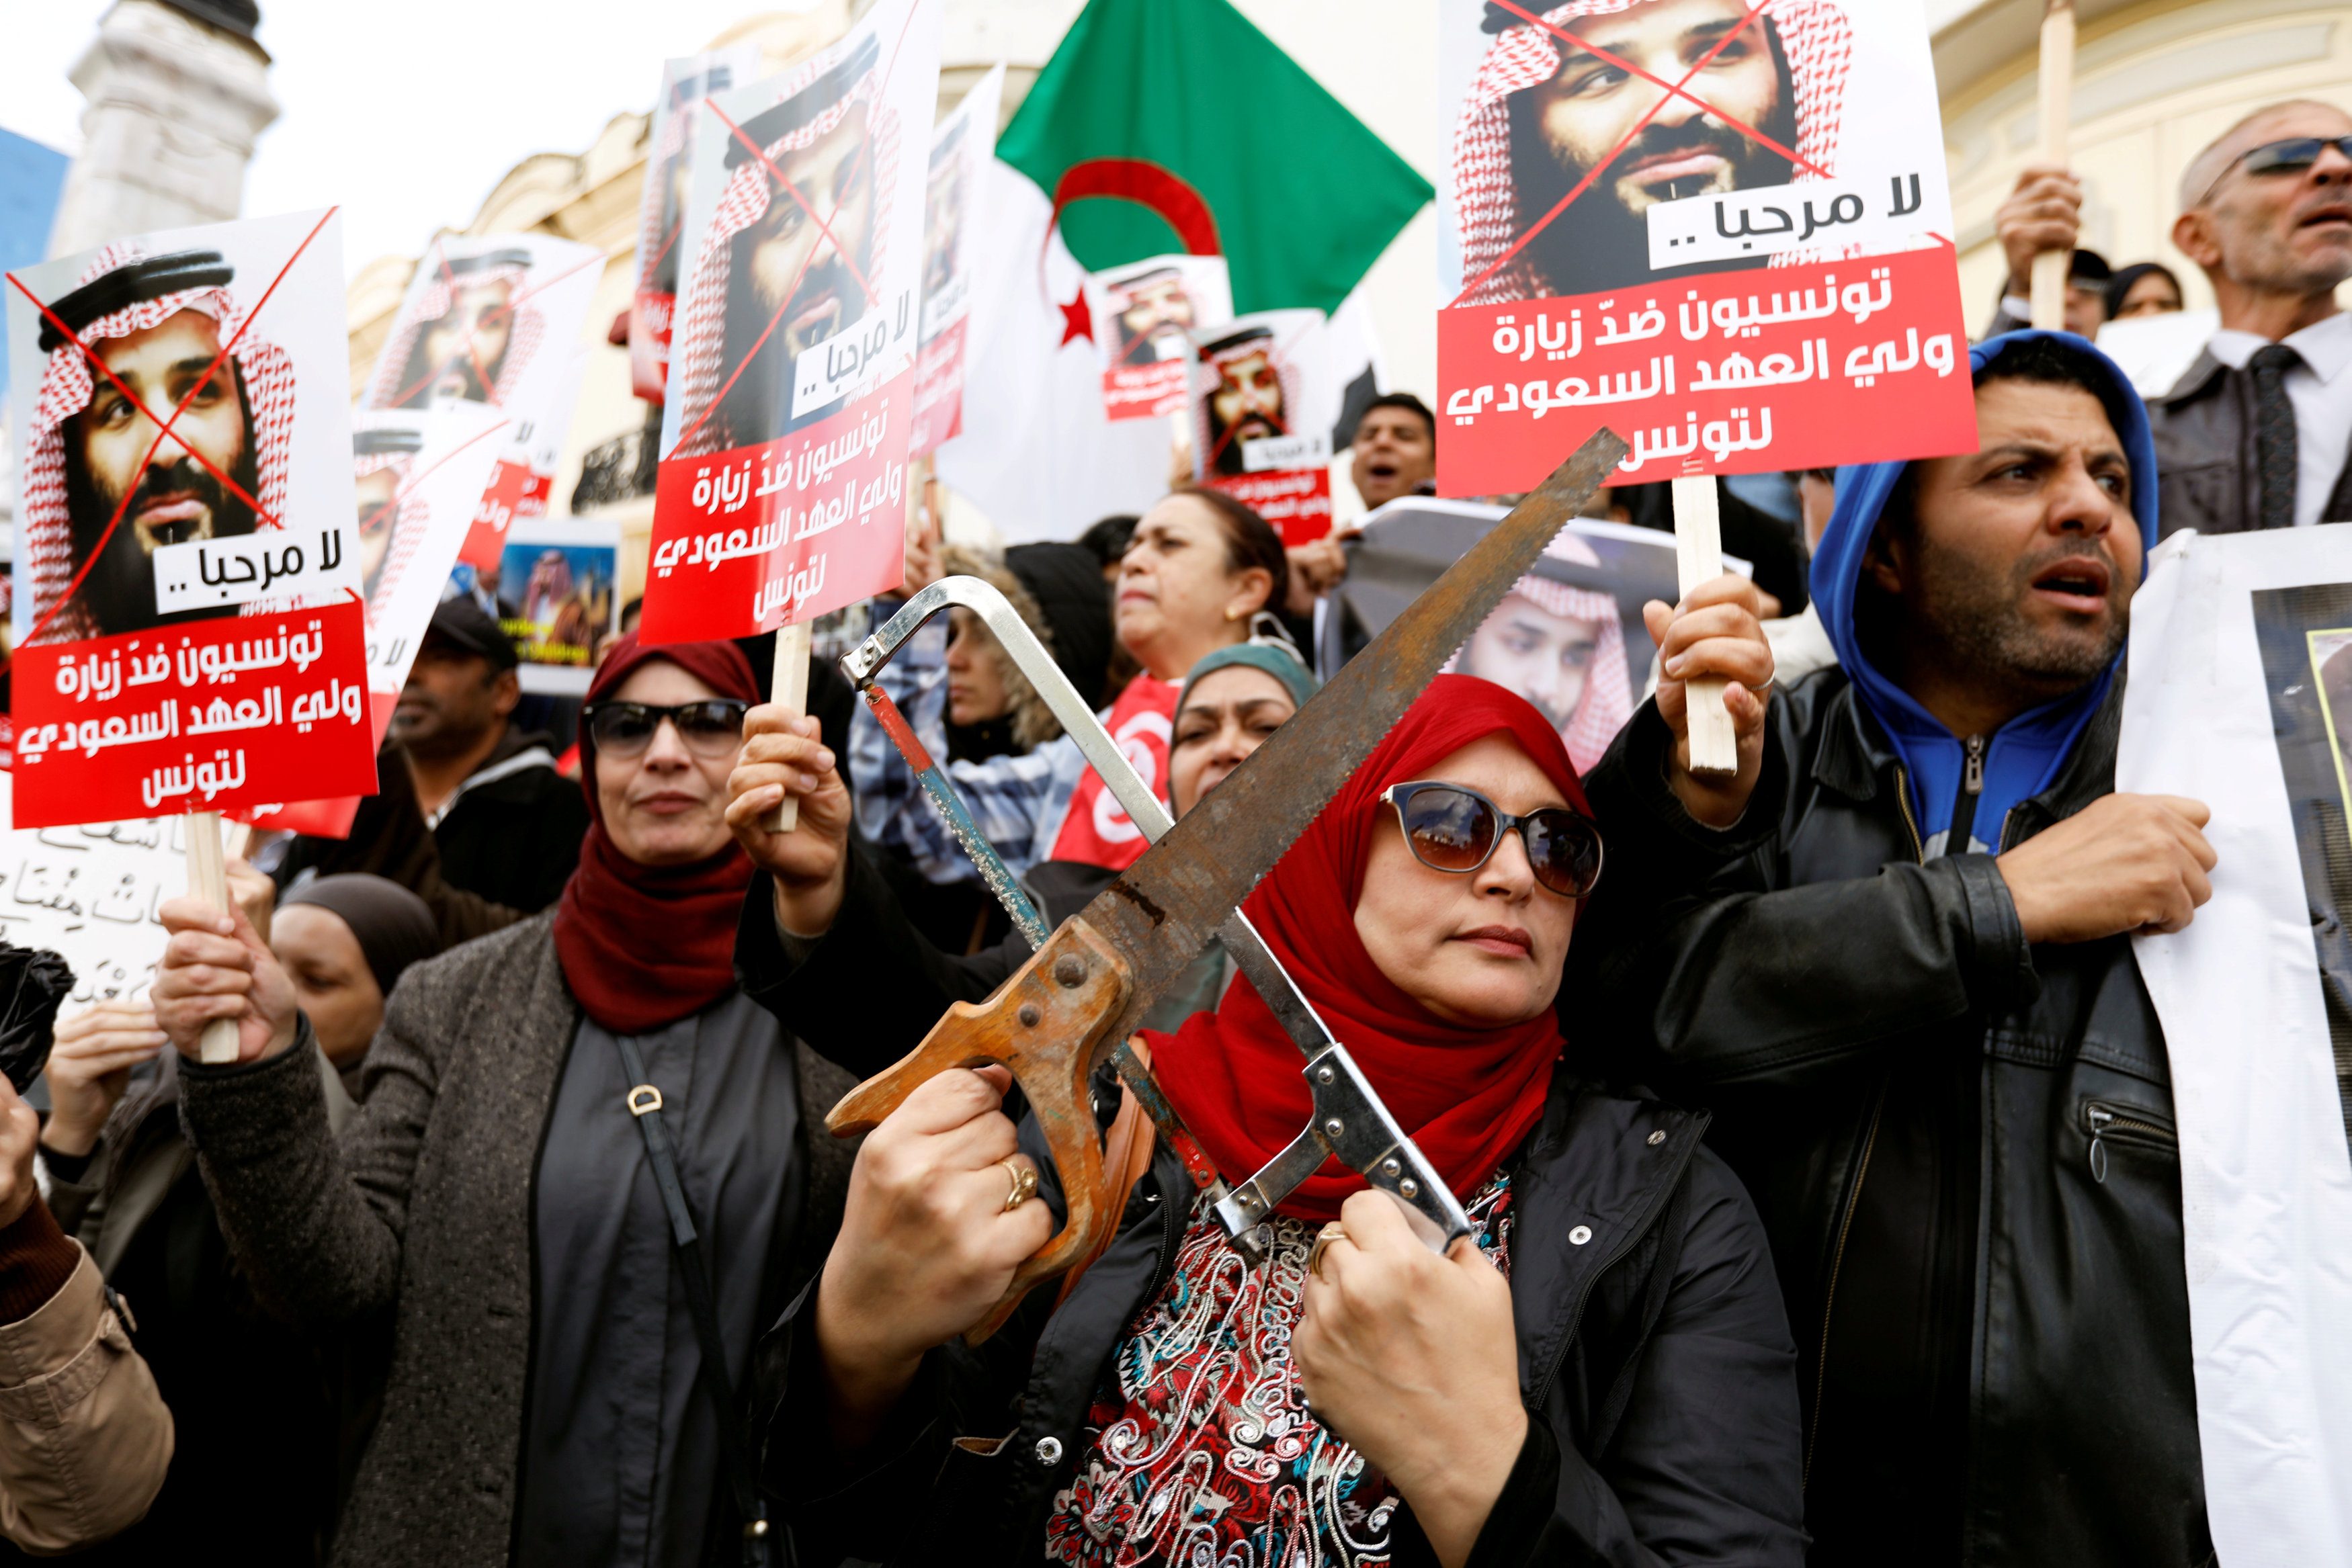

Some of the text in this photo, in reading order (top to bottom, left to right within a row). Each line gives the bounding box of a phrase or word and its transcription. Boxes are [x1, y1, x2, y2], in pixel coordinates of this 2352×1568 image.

[1716, 195, 1863, 249] مرحبا
[1888, 174, 1921, 216] لا
[894, 290, 909, 342] لا
[1679, 267, 1891, 341] تونسيون
[827, 320, 886, 392] مرحبا
[1493, 310, 1581, 361] زيارة
[1447, 328, 1954, 425] ولي العهد السعودي
[798, 398, 888, 489] تونسيون
[1618, 407, 1772, 472] لتونس
[693, 460, 751, 514] زيارة
[320, 530, 341, 571] لا
[655, 464, 901, 576] ولي العهد السعودي
[200, 546, 303, 597] مرحبا
[755, 555, 825, 620] لتونس
[56, 650, 120, 701] زيارة
[177, 620, 322, 686] تونسيون
[18, 679, 361, 763] ولي العهد السعودي
[143, 750, 245, 807] لتونس
